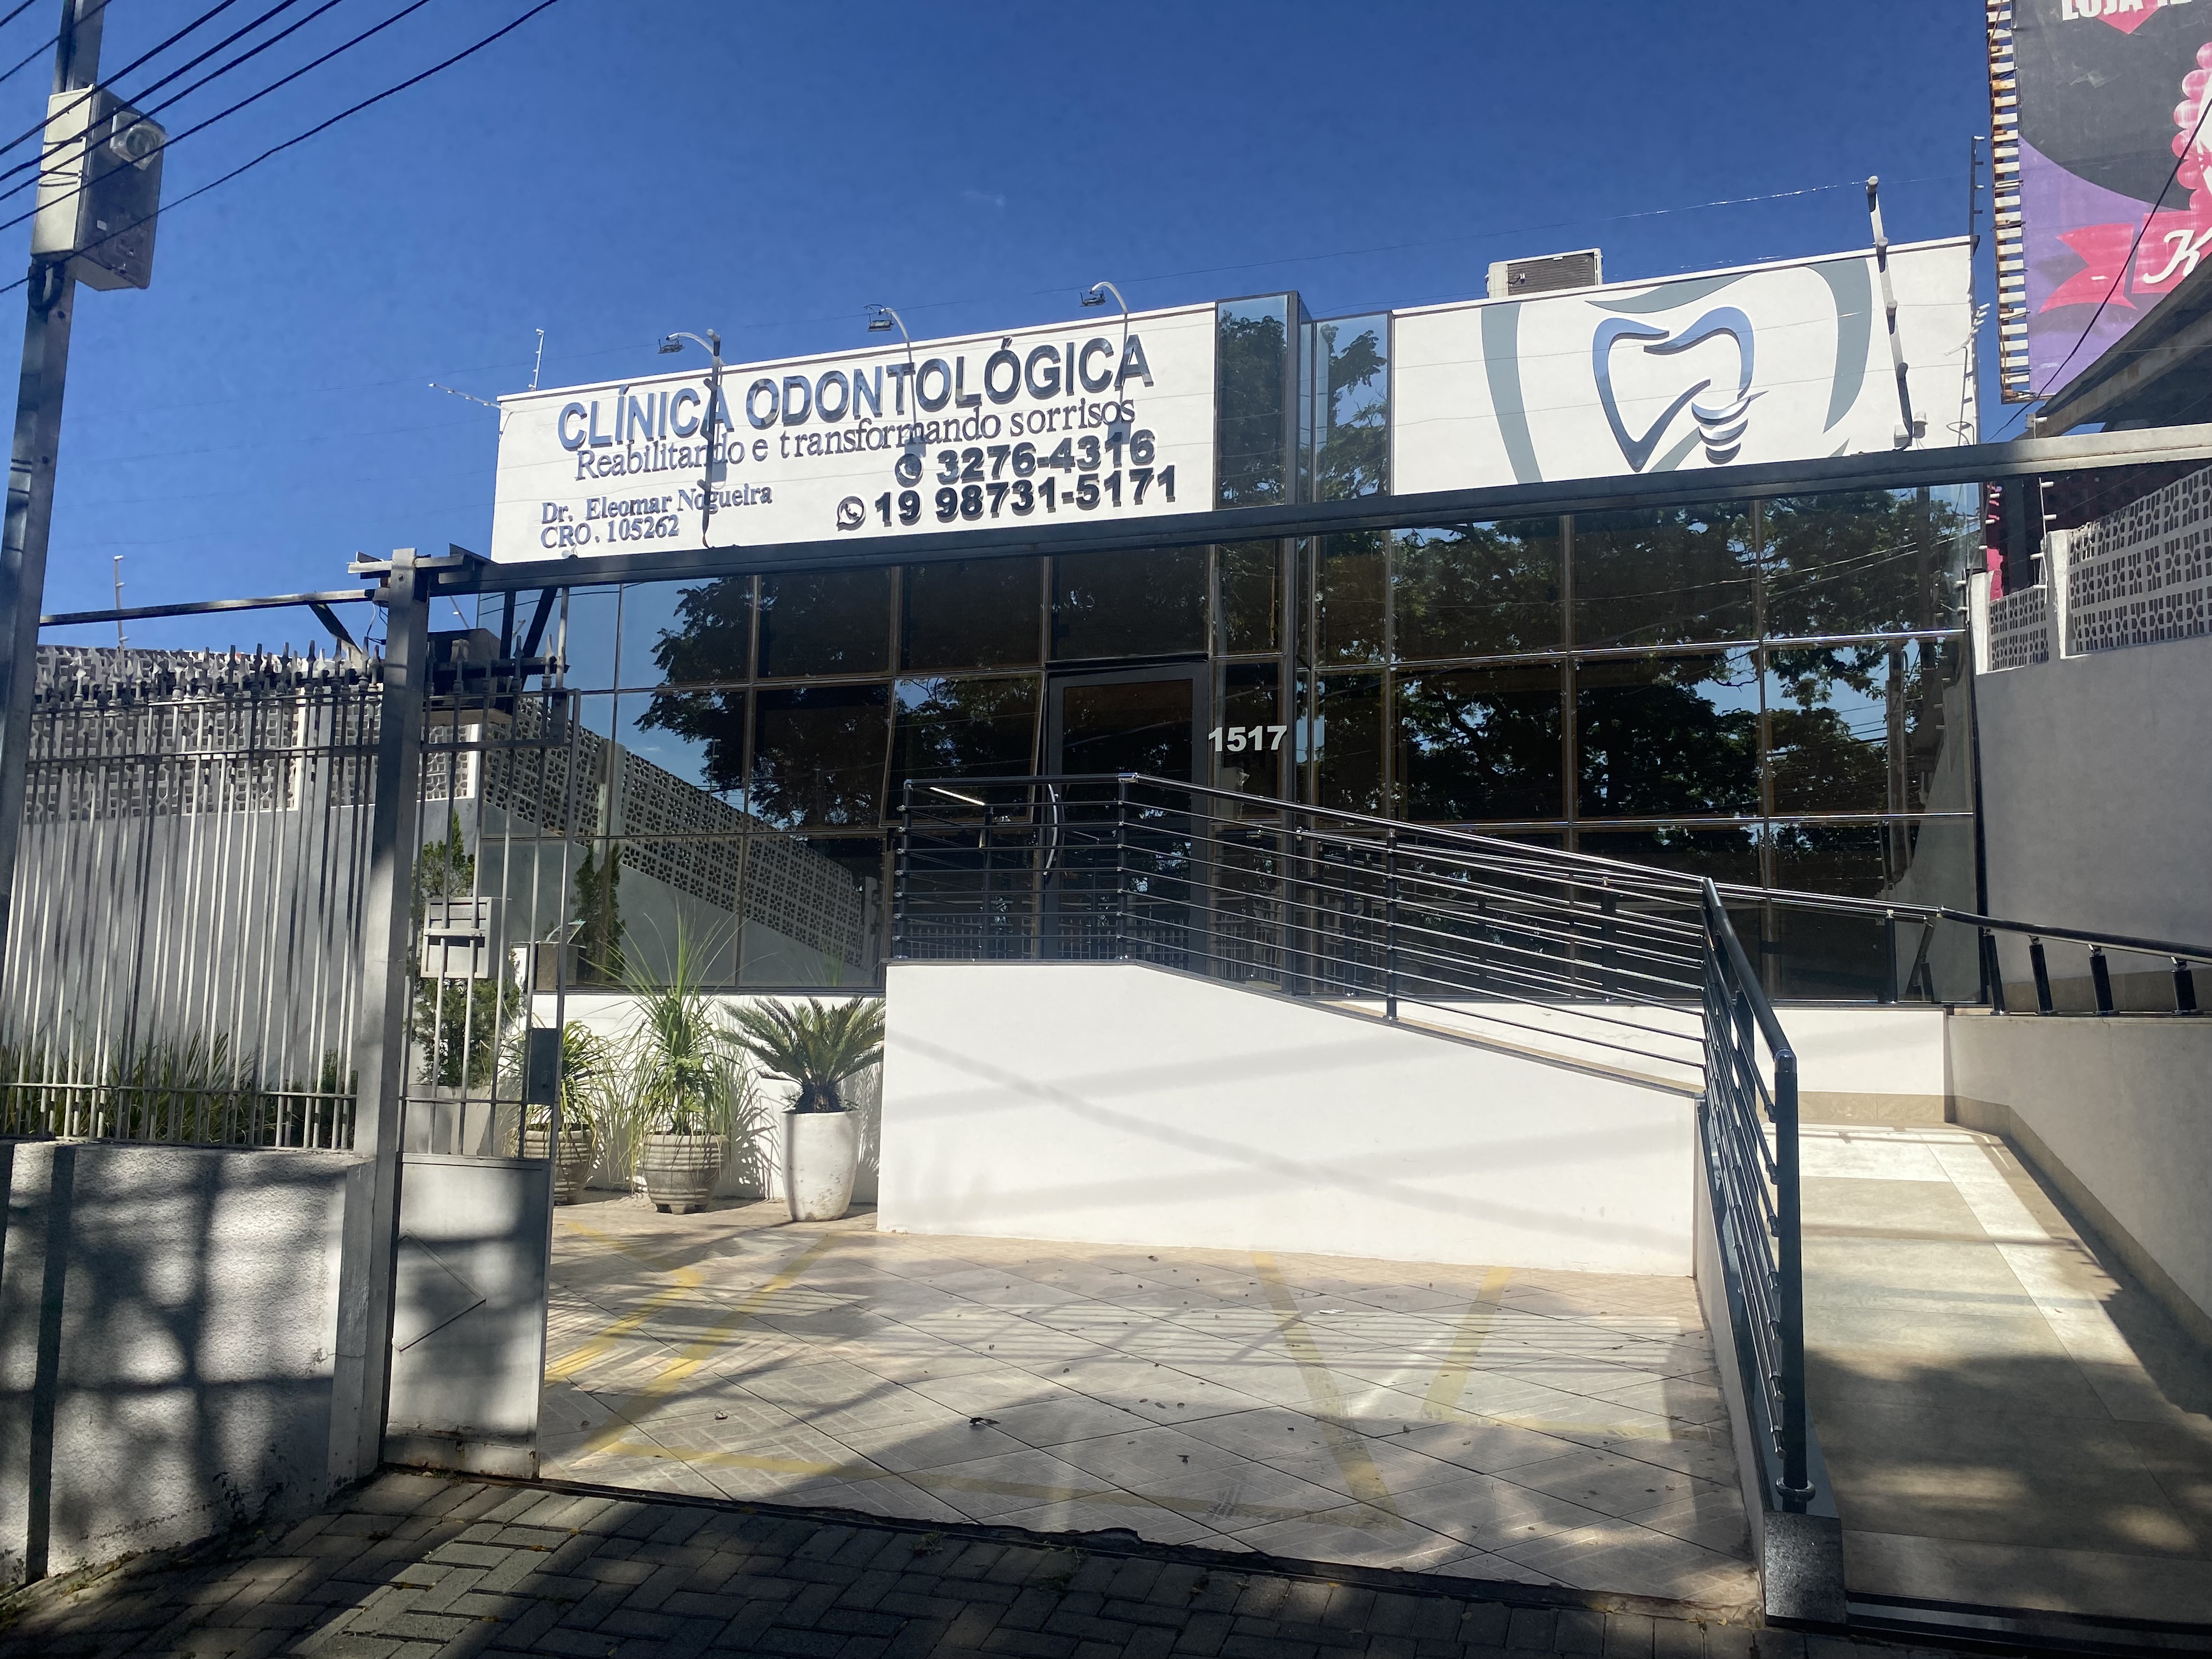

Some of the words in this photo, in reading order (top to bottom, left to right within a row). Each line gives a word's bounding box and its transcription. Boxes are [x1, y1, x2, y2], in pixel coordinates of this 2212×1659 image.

[558, 385, 734, 452] CLÍNICA
[746, 335, 1154, 430] ODONTOLÓGICA
[575, 432, 746, 481] Reabilitando
[752, 438, 769, 461] e
[779, 405, 1002, 459] transformando
[1009, 397, 1136, 437] sorrisos
[936, 429, 1155, 485] 3276-4316
[541, 501, 574, 524] Dr.
[585, 495, 673, 521] Eleomar
[676, 483, 772, 515] Nogueira
[875, 489, 923, 527] 19
[935, 465, 1177, 523] 98731-5171
[607, 514, 680, 543] 105262
[1208, 725, 1288, 752] 1517
